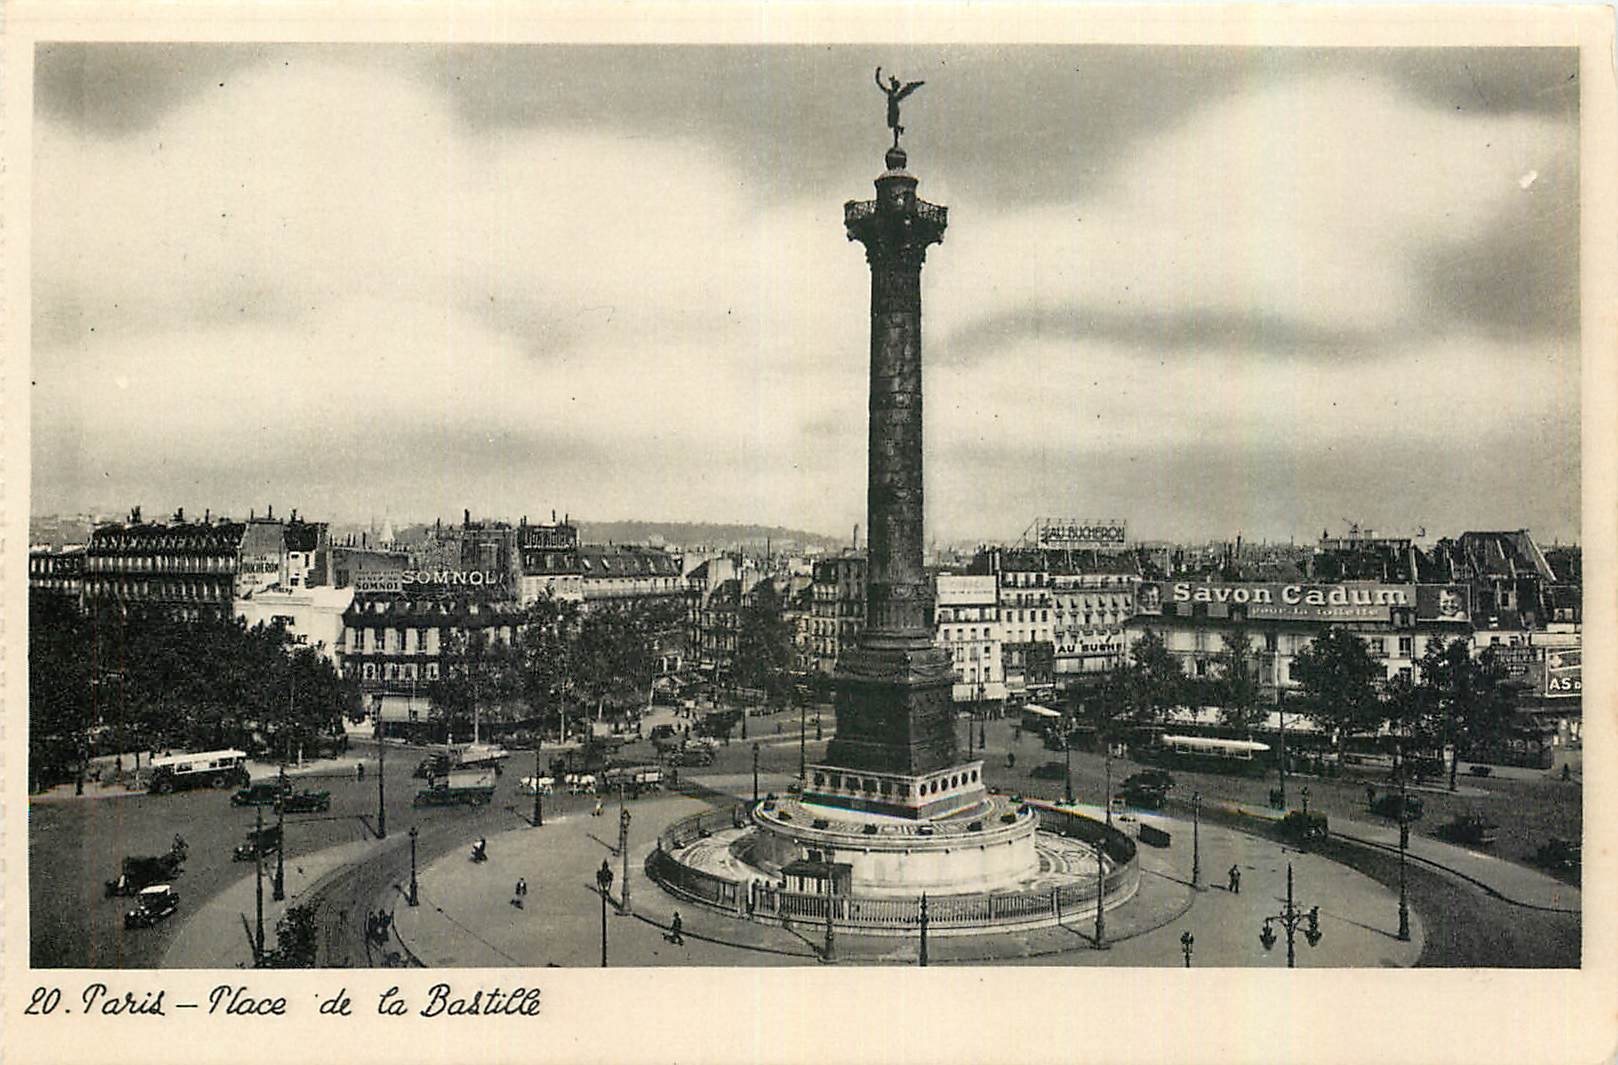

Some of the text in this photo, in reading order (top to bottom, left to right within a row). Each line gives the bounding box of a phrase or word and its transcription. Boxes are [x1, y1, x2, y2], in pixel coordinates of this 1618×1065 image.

[402, 570, 497, 585] SOMNOL
[1173, 582, 1408, 606] Savon Cadum
[1057, 645, 1075, 653] AU
[1549, 677, 1572, 691] AS
